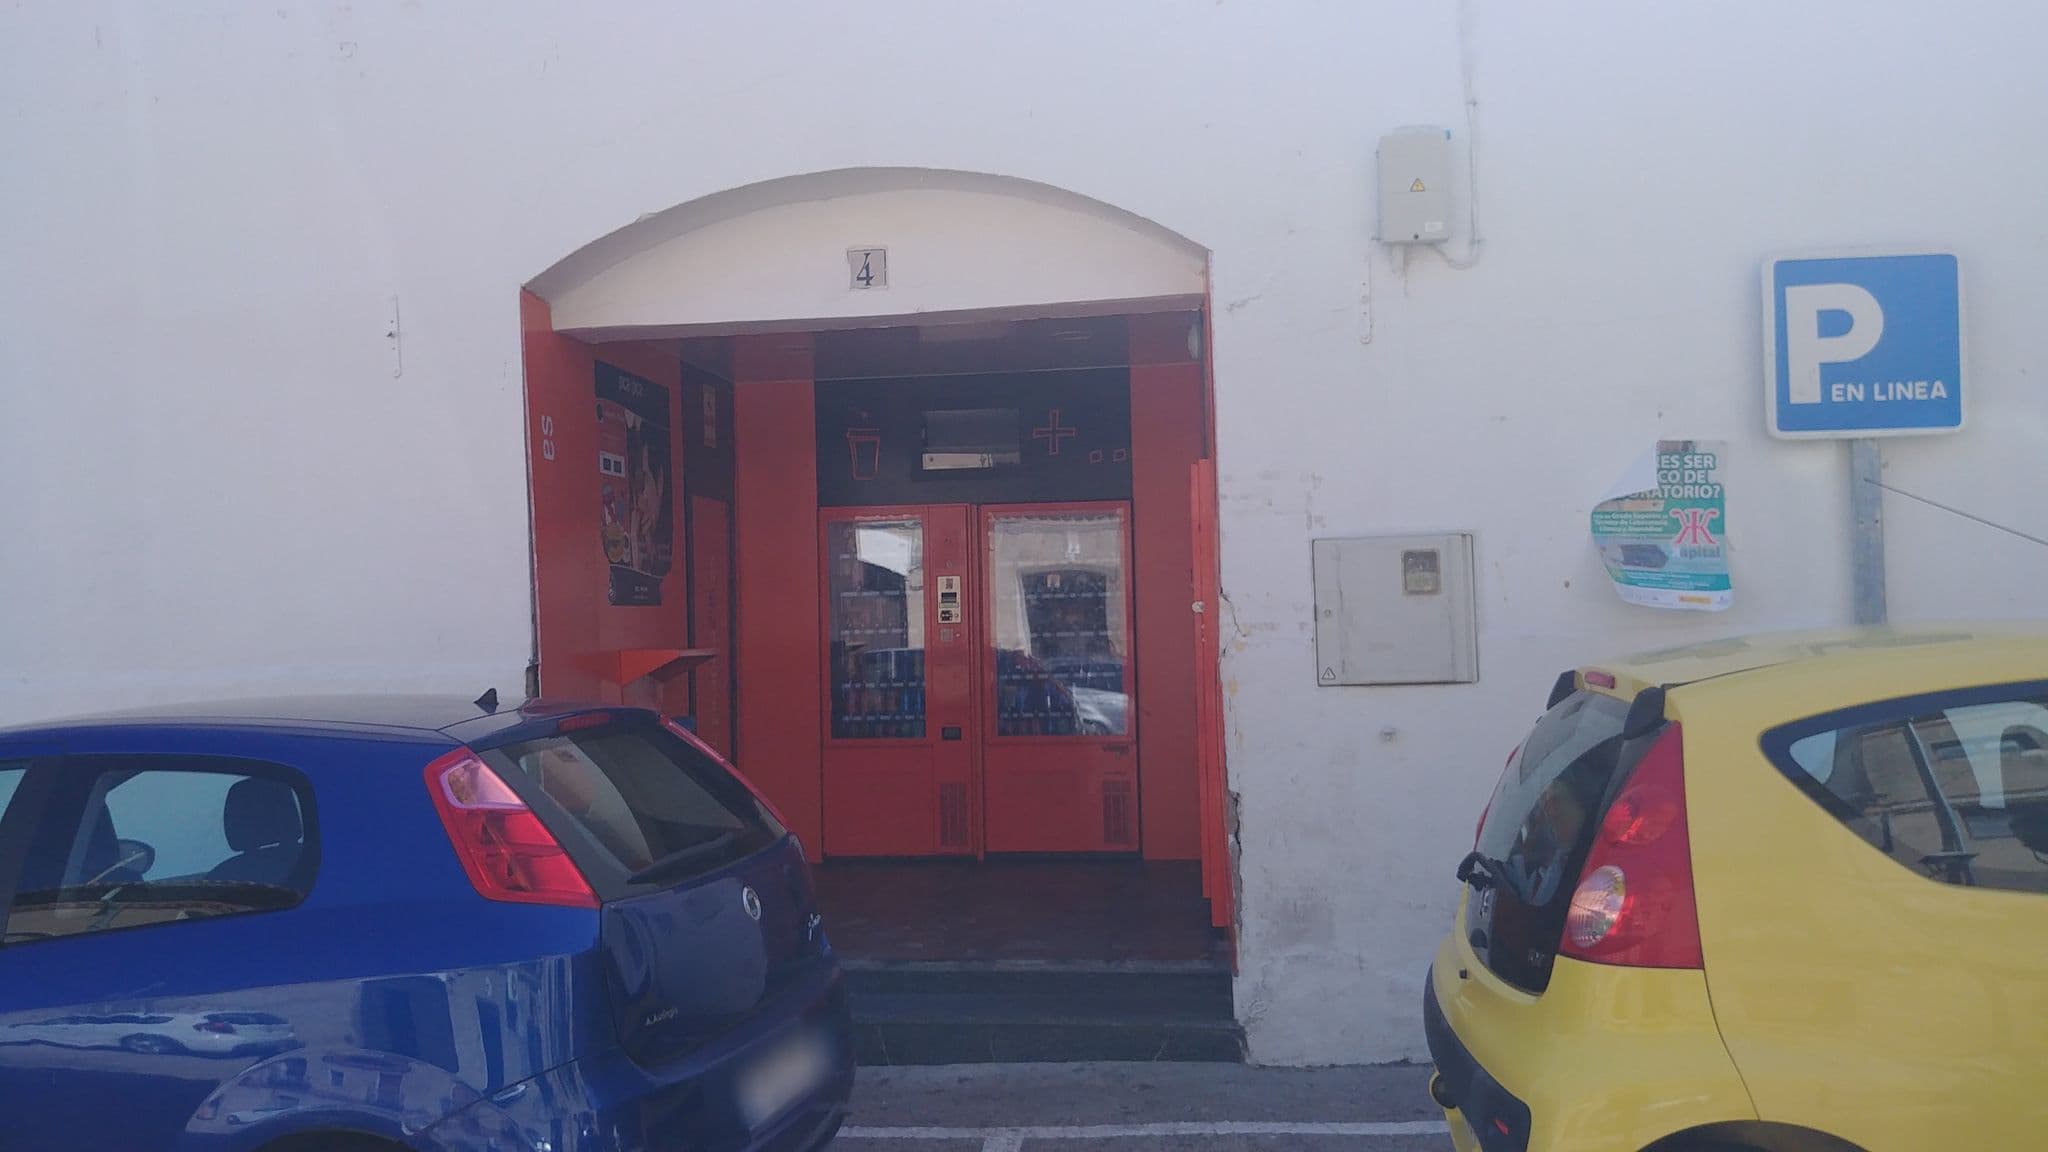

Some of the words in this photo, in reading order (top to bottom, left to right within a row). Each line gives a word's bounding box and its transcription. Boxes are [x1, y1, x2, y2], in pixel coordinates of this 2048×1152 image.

[856, 252, 875, 287] 4
[1785, 282, 1885, 405] P
[1831, 383, 1865, 402] EN
[1873, 380, 1948, 401] LINEA
[1658, 454, 1680, 469] ES
[1683, 454, 1714, 469] SER
[1684, 470, 1706, 484] DE
